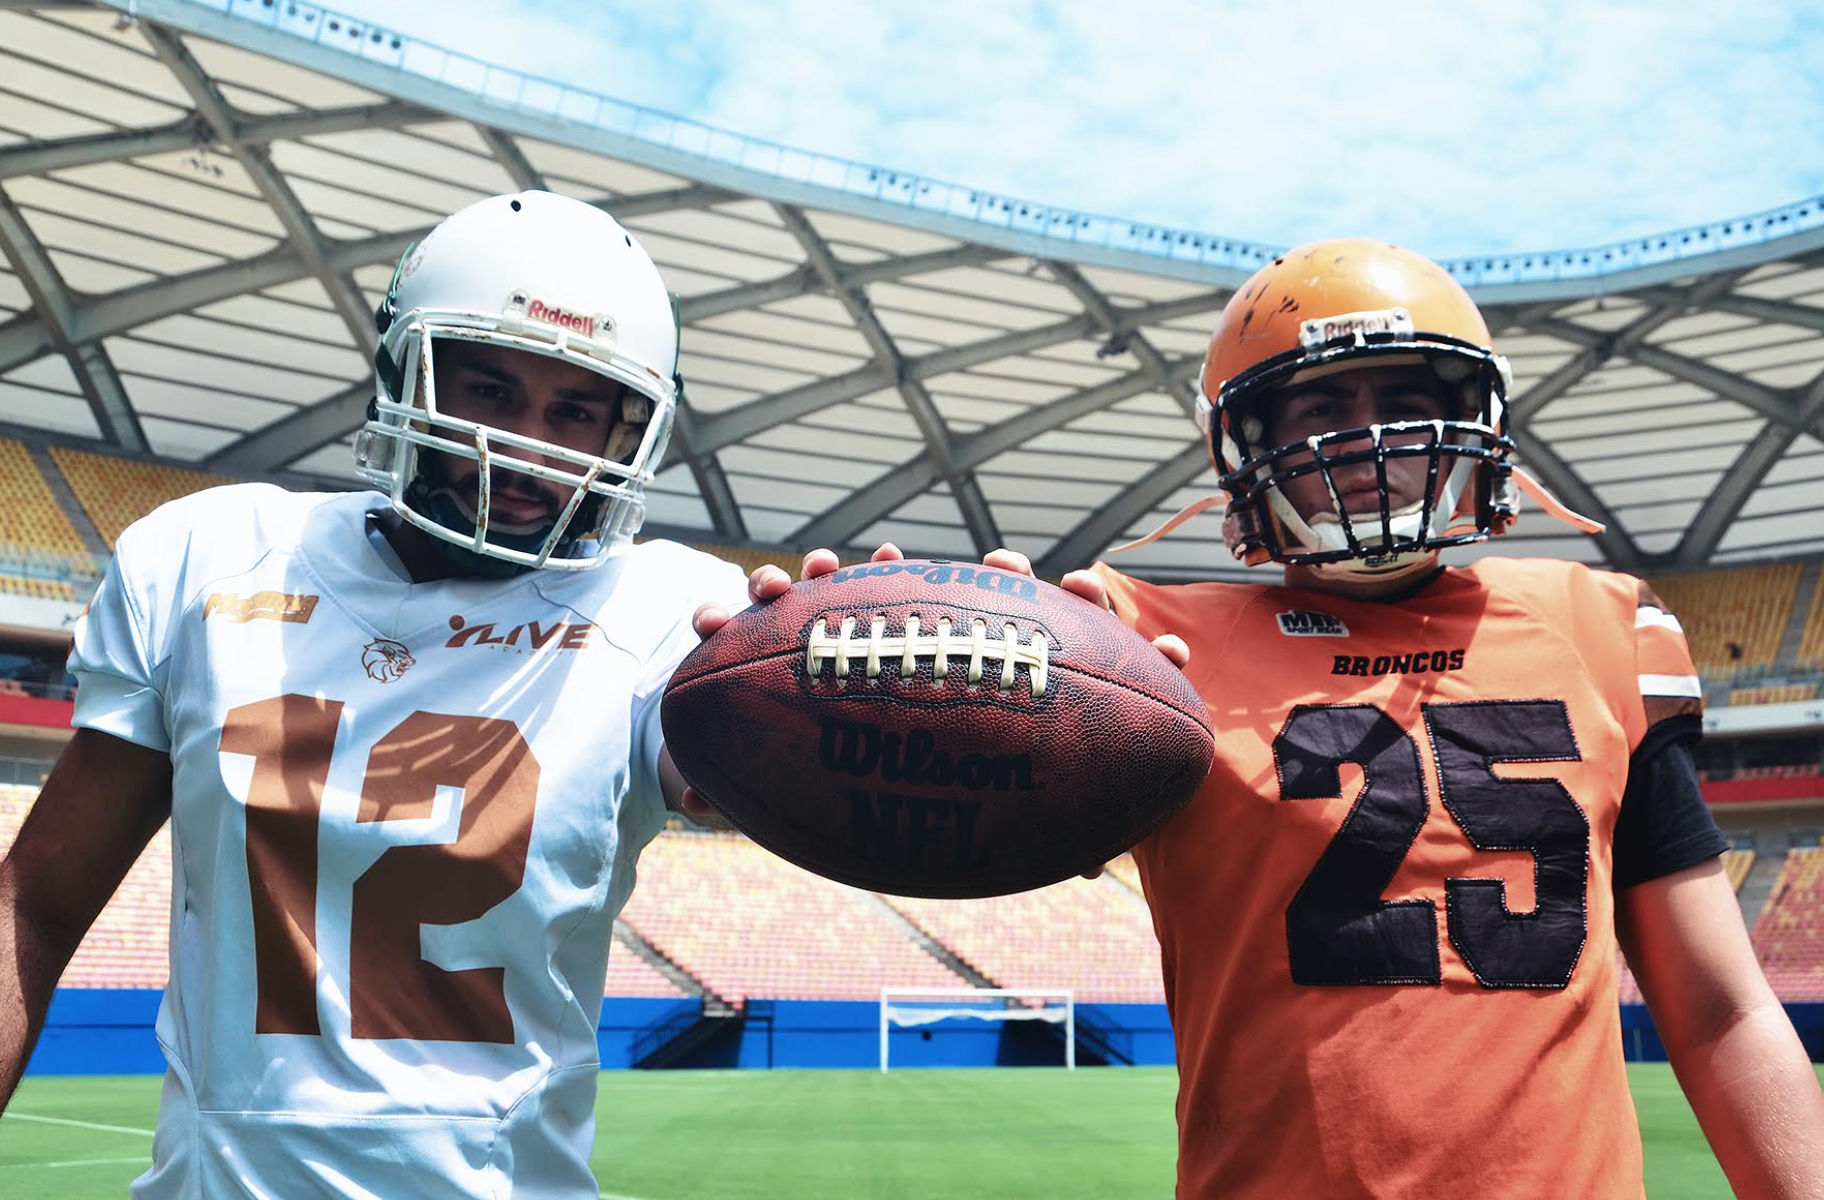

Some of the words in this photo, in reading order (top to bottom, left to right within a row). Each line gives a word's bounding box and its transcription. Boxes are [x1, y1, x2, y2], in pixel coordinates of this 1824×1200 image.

[528, 299, 594, 336] Riddell
[831, 563, 1038, 604] Wilson
[1331, 649, 1465, 676] BRONCOS
[819, 716, 1032, 790] Wilson
[849, 782, 988, 873] NFL
[1271, 698, 1590, 990] 25
[217, 692, 542, 1045] 12
